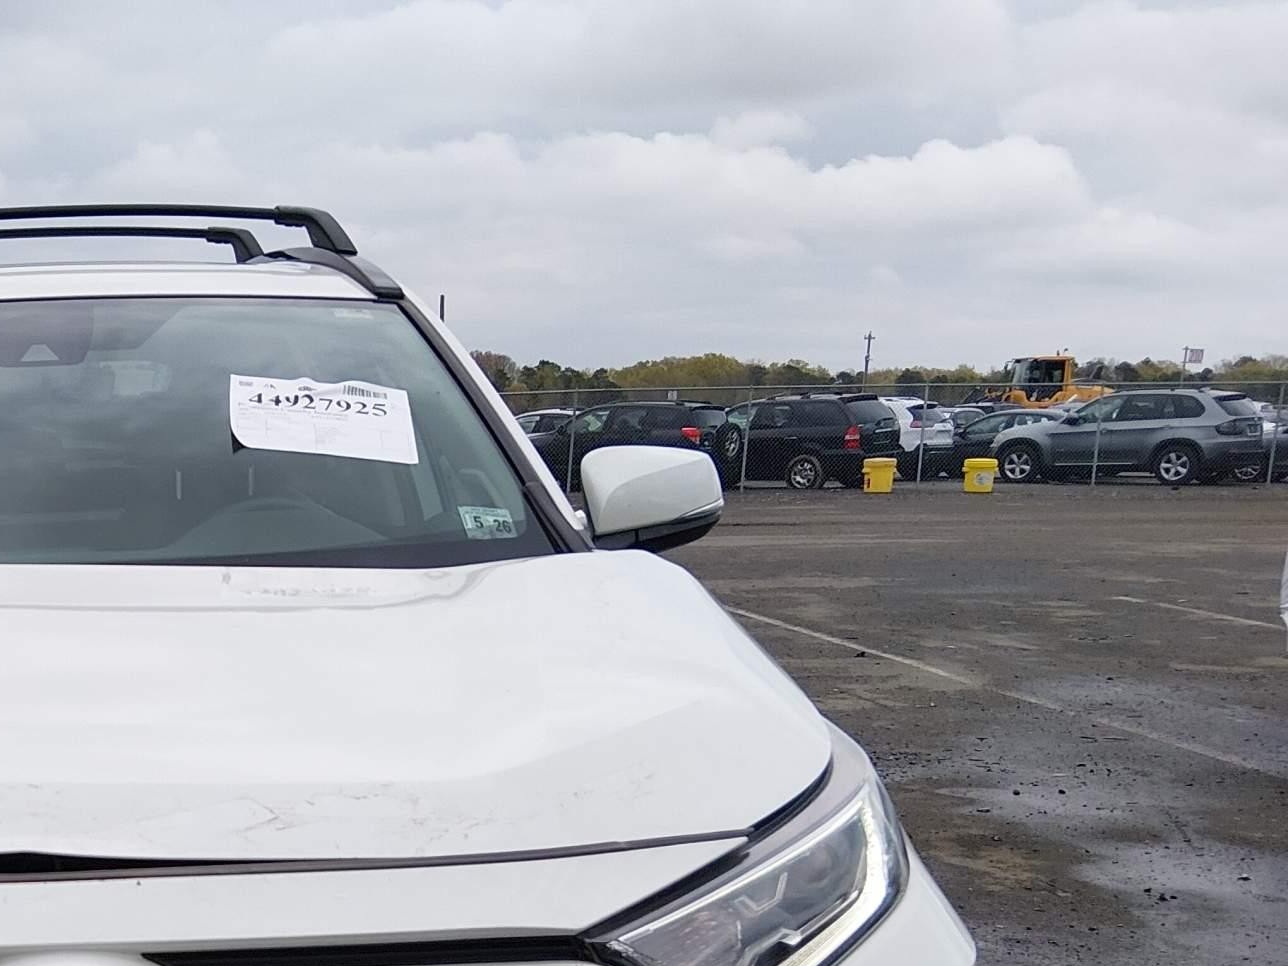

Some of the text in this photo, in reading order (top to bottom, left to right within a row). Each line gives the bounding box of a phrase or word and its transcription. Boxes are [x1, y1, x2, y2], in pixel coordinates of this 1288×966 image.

[248, 392, 388, 417] 44927925
[473, 515, 512, 533] 5 26
